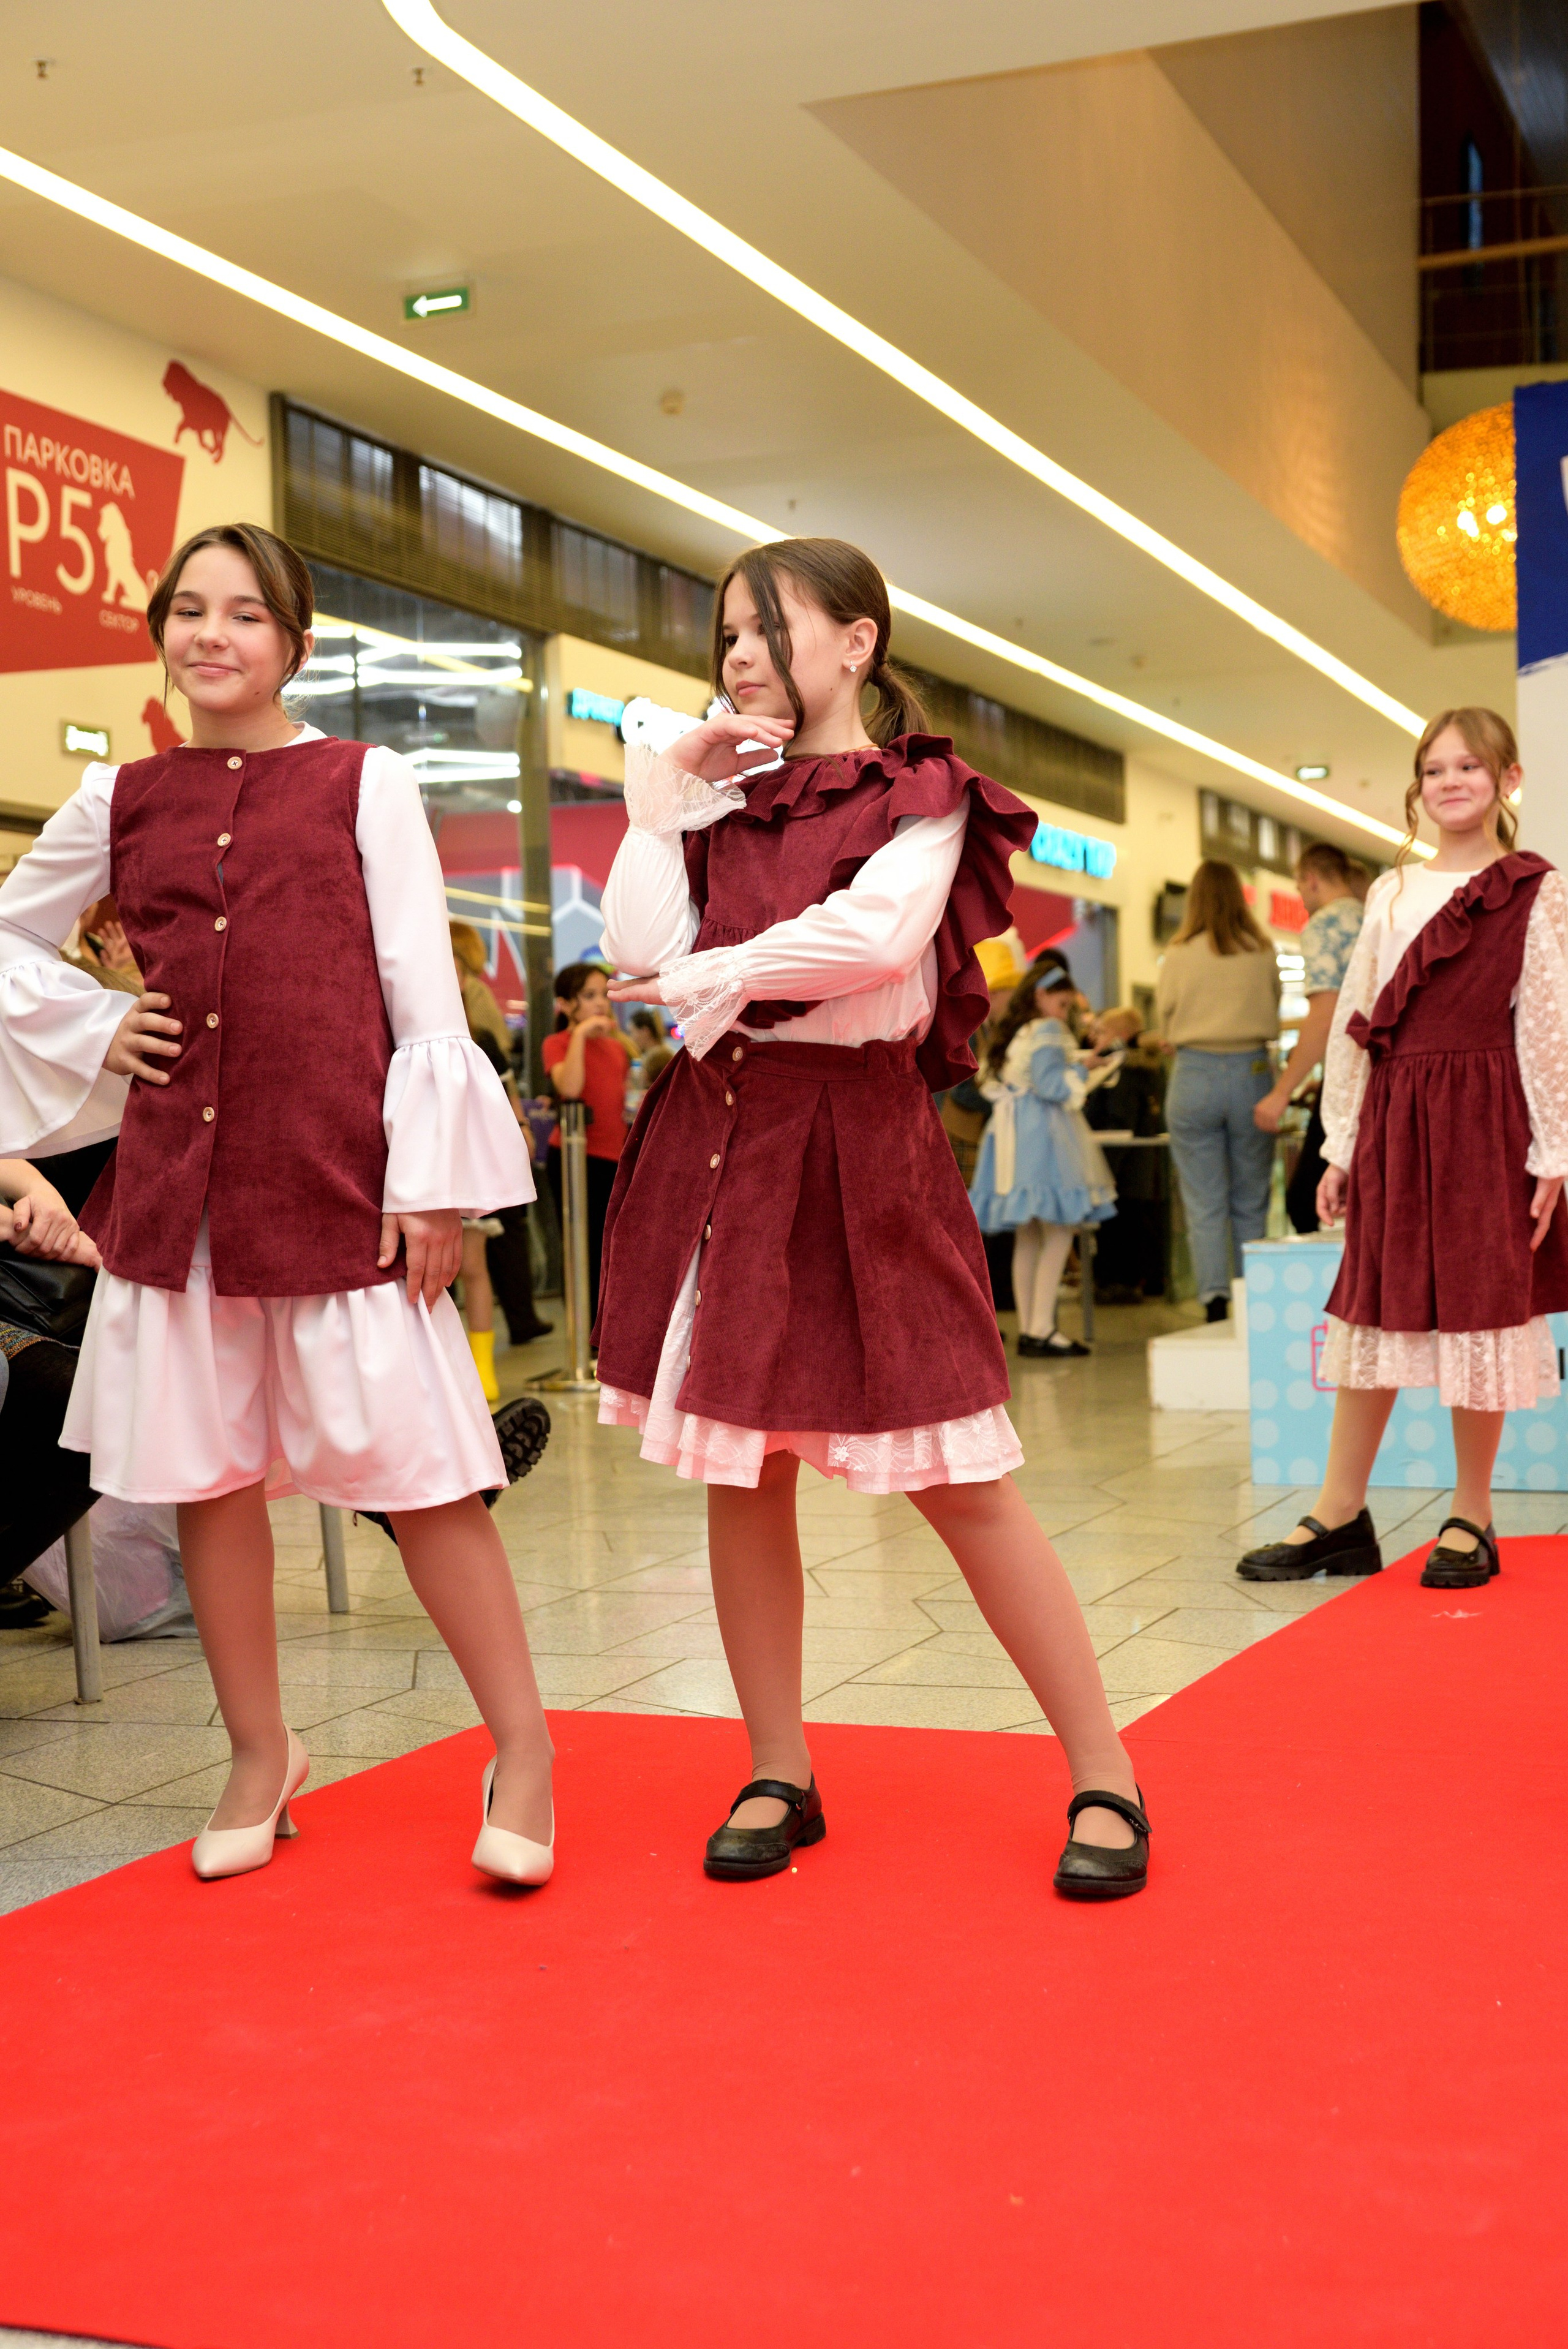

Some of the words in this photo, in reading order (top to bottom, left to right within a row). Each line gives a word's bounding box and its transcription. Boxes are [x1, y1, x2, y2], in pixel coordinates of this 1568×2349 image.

[4, 423, 136, 500] ПАРКОВКА
[6, 466, 95, 596] P5
[11, 586, 62, 614] УРОВЕНЬ
[99, 609, 140, 633] СЕКТОР
